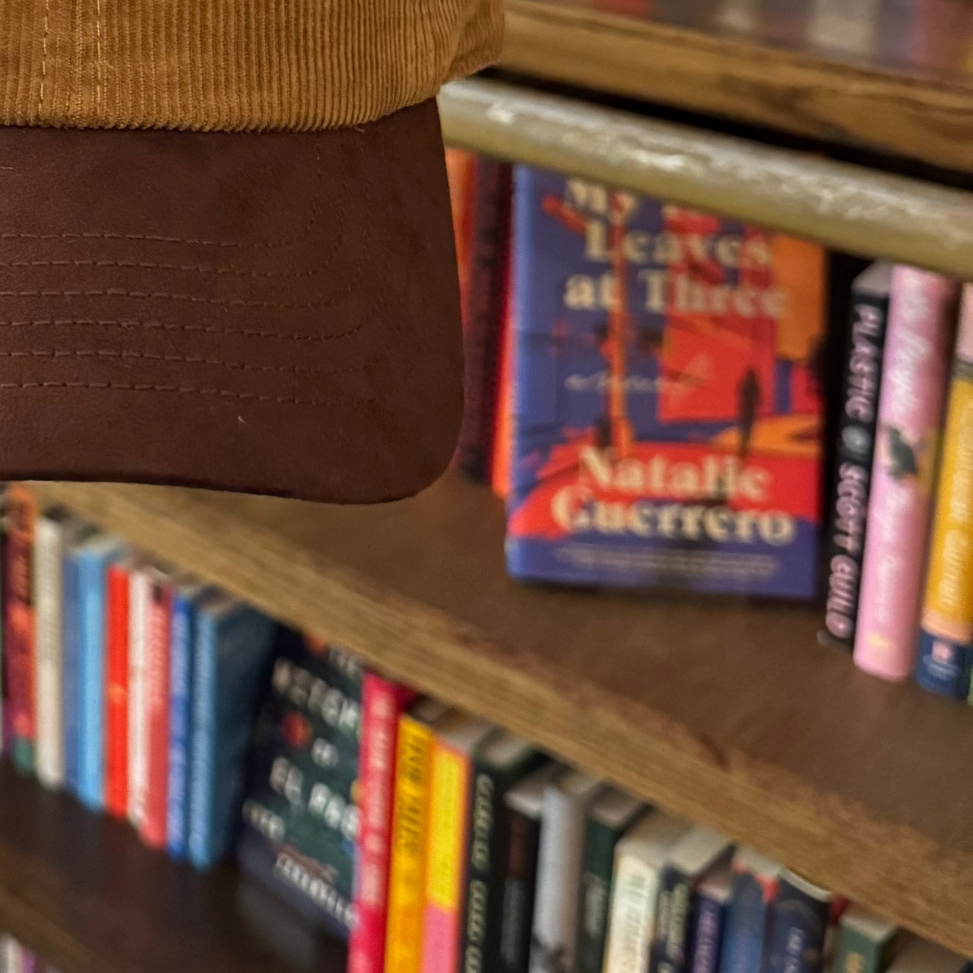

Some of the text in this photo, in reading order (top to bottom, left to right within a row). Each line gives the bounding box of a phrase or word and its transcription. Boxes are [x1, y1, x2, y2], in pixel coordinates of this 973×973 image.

[584, 220, 774, 270] Leaves
[563, 269, 792, 319] at Three
[577, 444, 773, 503] Natalie
[825, 302, 884, 639] PLASTIC SCOTT GUILD
[550, 484, 799, 547] Guerrero
